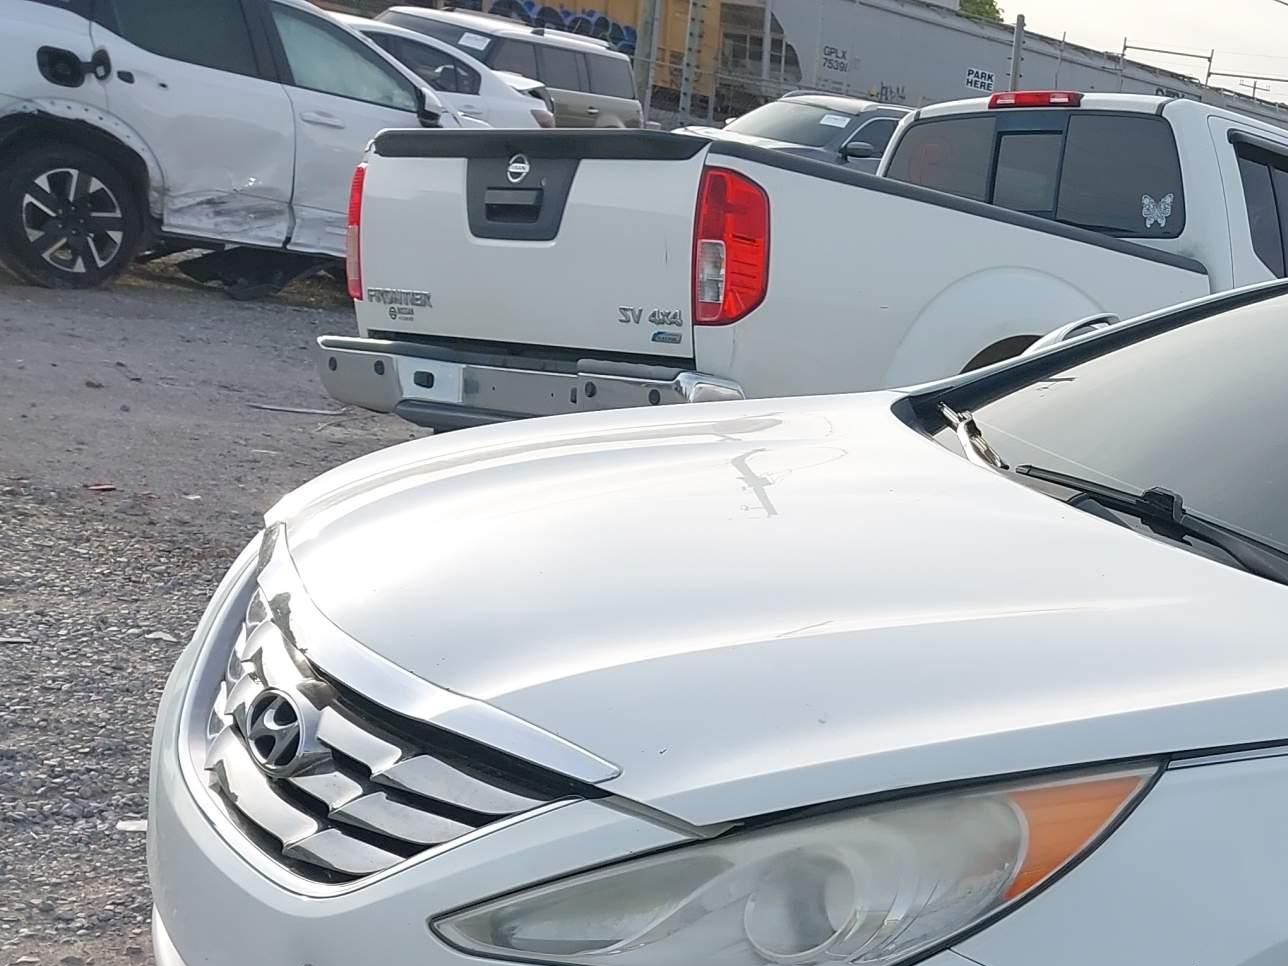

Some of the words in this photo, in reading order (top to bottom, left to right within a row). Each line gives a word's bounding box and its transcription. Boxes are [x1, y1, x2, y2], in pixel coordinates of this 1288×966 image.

[967, 69, 994, 83] PARK
[966, 78, 993, 91] HERE
[618, 306, 643, 325] SV
